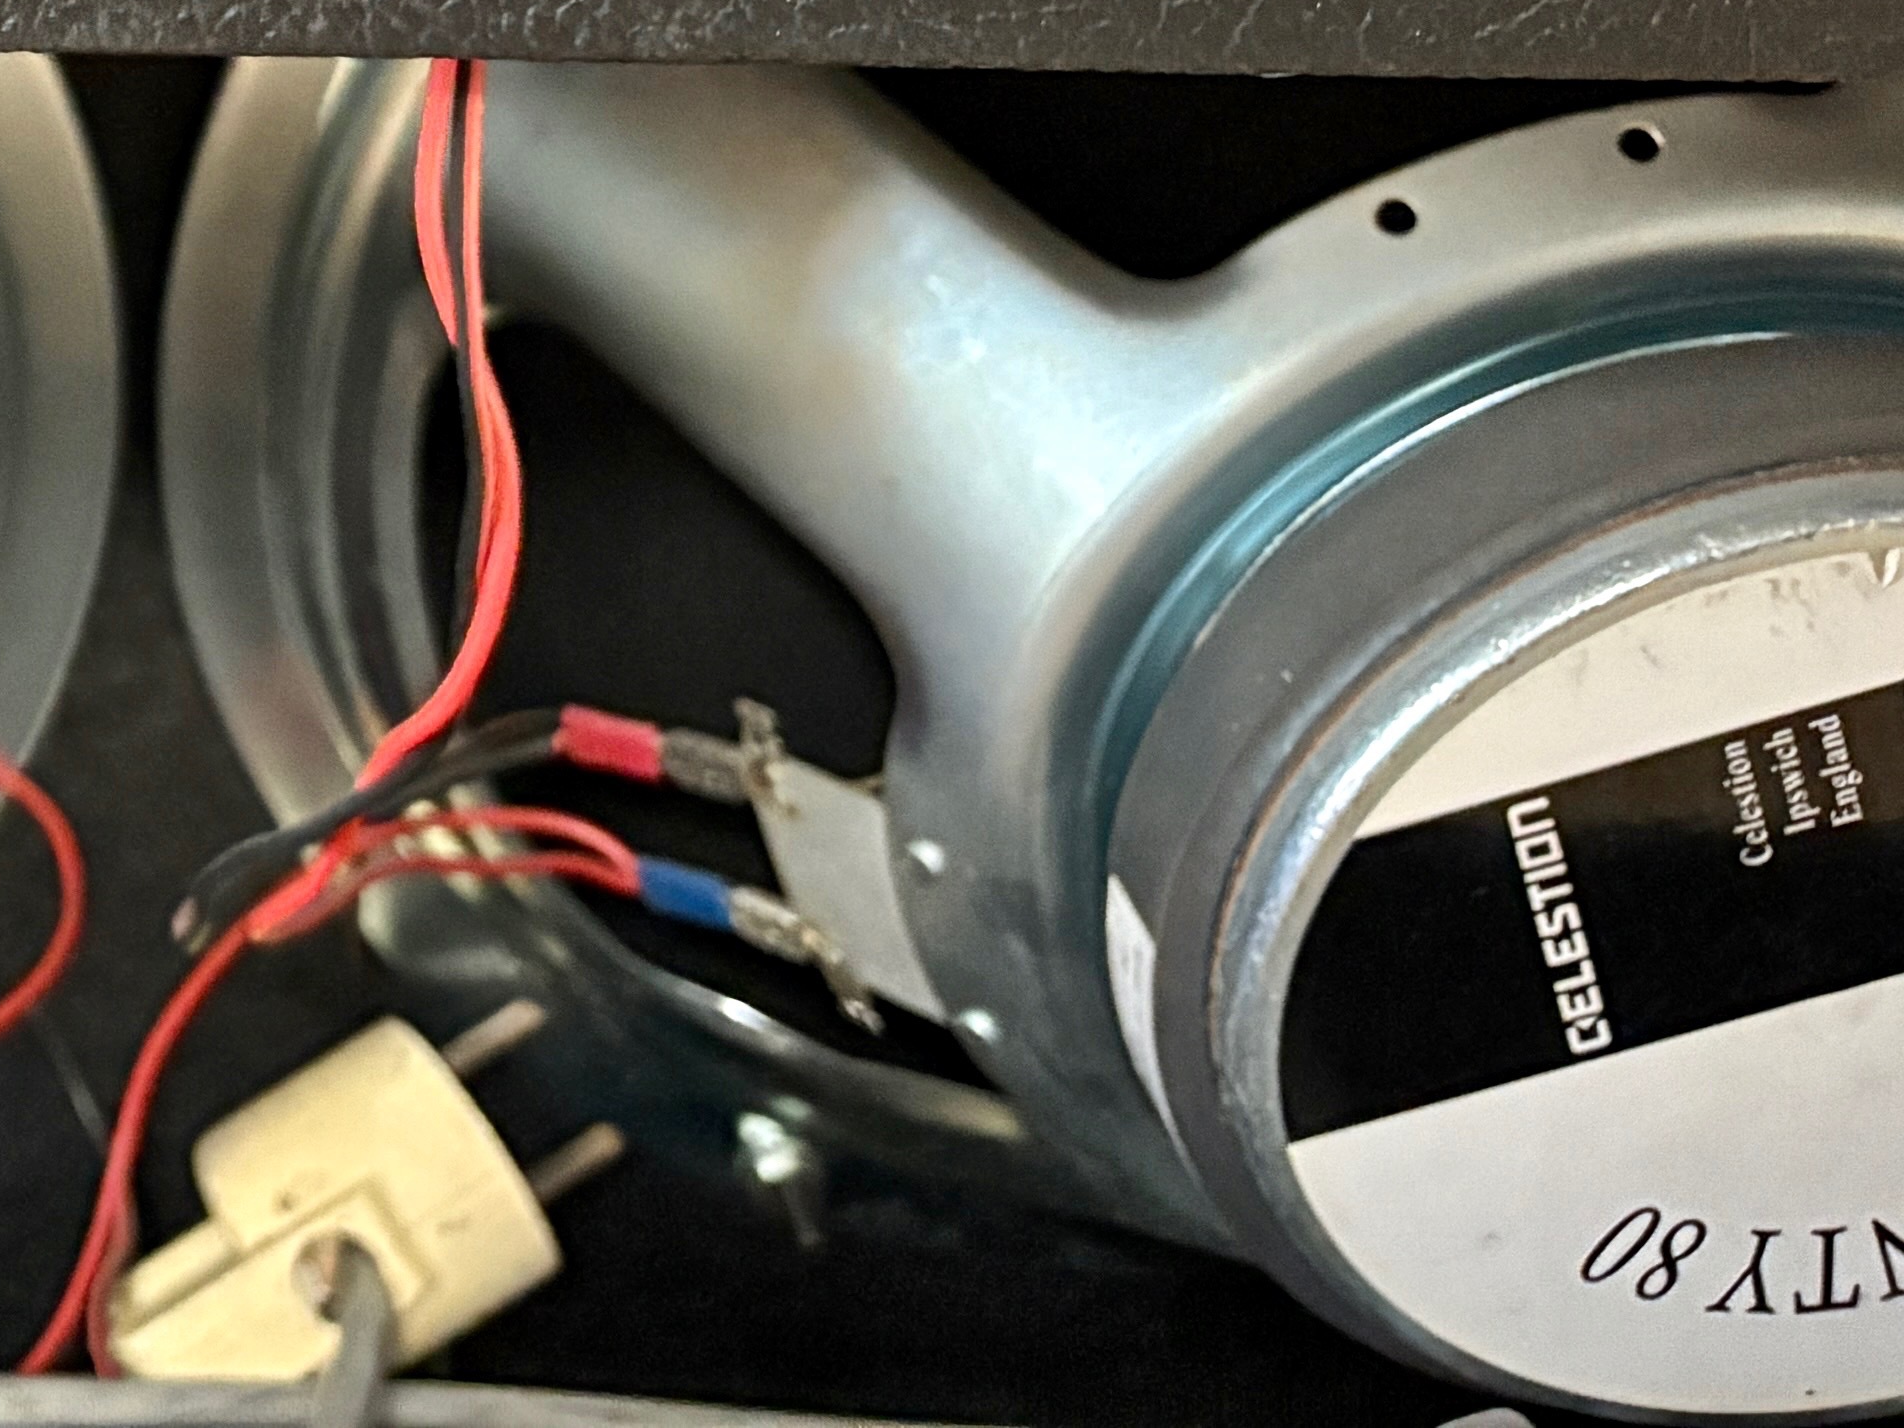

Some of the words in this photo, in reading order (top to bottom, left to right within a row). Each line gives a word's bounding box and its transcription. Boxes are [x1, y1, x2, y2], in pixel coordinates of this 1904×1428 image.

[1721, 739, 1774, 867] Celestion
[1762, 726, 1821, 836] Ipswich
[1807, 713, 1864, 828] England
[1506, 795, 1613, 1056] CELESTION
[1579, 1206, 1708, 1302] 80
